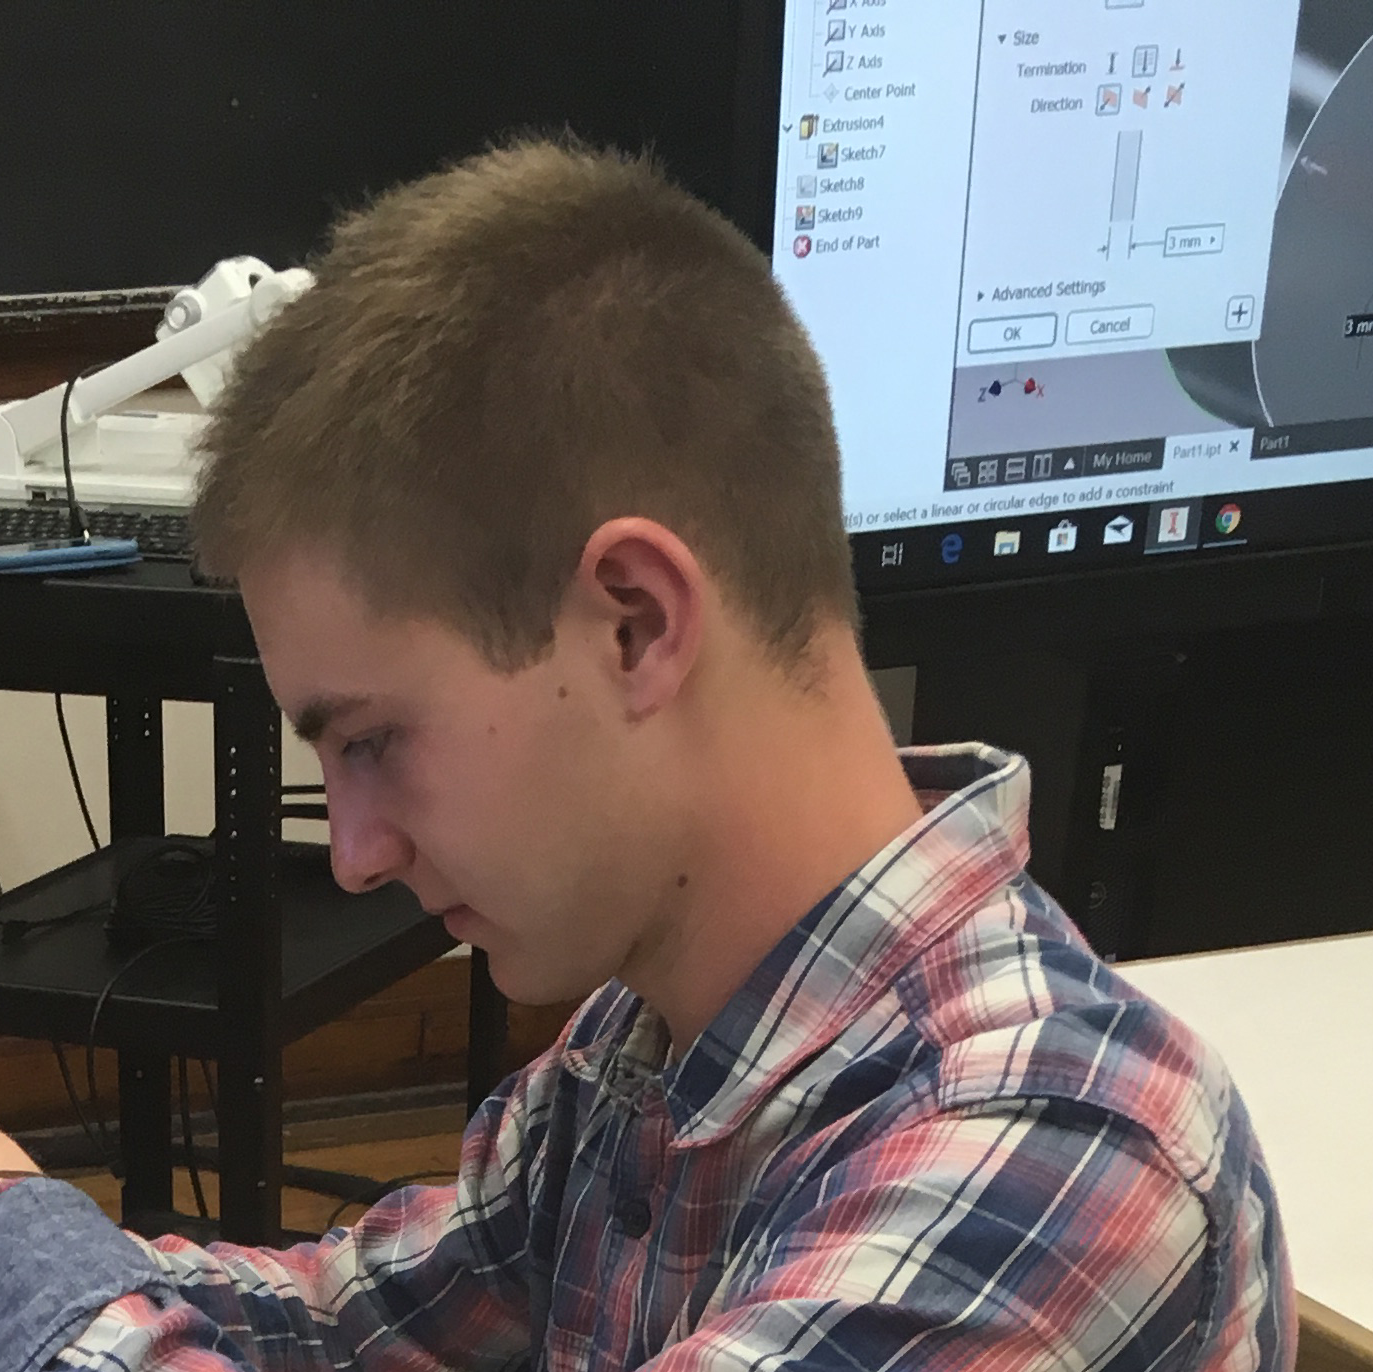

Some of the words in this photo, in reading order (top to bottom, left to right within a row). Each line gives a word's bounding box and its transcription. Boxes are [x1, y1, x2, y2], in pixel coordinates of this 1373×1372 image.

[848, 24, 857, 39] Y
[860, 24, 886, 38] Axis
[1012, 29, 1040, 46] Size
[845, 55, 855, 70] Z
[858, 54, 883, 69] Axis
[1017, 61, 1087, 78] Termination
[844, 85, 883, 101] Center
[885, 83, 917, 98] Point
[1030, 97, 1083, 113] Direction
[823, 115, 884, 133] Extrusion4
[841, 145, 886, 162] Sketch7
[819, 177, 865, 194] Sketch8
[817, 206, 863, 223] Sketch9
[816, 238, 839, 254] End
[841, 235, 855, 251] of
[857, 235, 881, 250] Part
[1168, 236, 1177, 249] 3
[1180, 236, 1202, 249] mm
[991, 282, 1053, 301] Advanced
[1056, 279, 1106, 298] Settings
[1003, 326, 1022, 342] OK
[1090, 317, 1131, 335] Cancel
[1344, 318, 1354, 335] 3
[1260, 434, 1290, 450] Part1
[1092, 452, 1112, 470] My
[1115, 449, 1153, 466] Home
[1173, 442, 1222, 460] Part1.ipt
[866, 514, 879, 526] or
[883, 507, 917, 523] select
[920, 508, 928, 519] a
[931, 503, 962, 519] linear
[966, 501, 981, 515] or
[983, 495, 1025, 513] circular
[1028, 491, 1059, 510] edge
[1062, 491, 1076, 505] to
[1078, 486, 1103, 502] add
[1105, 486, 1113, 498] a
[1115, 479, 1175, 498] constraint
